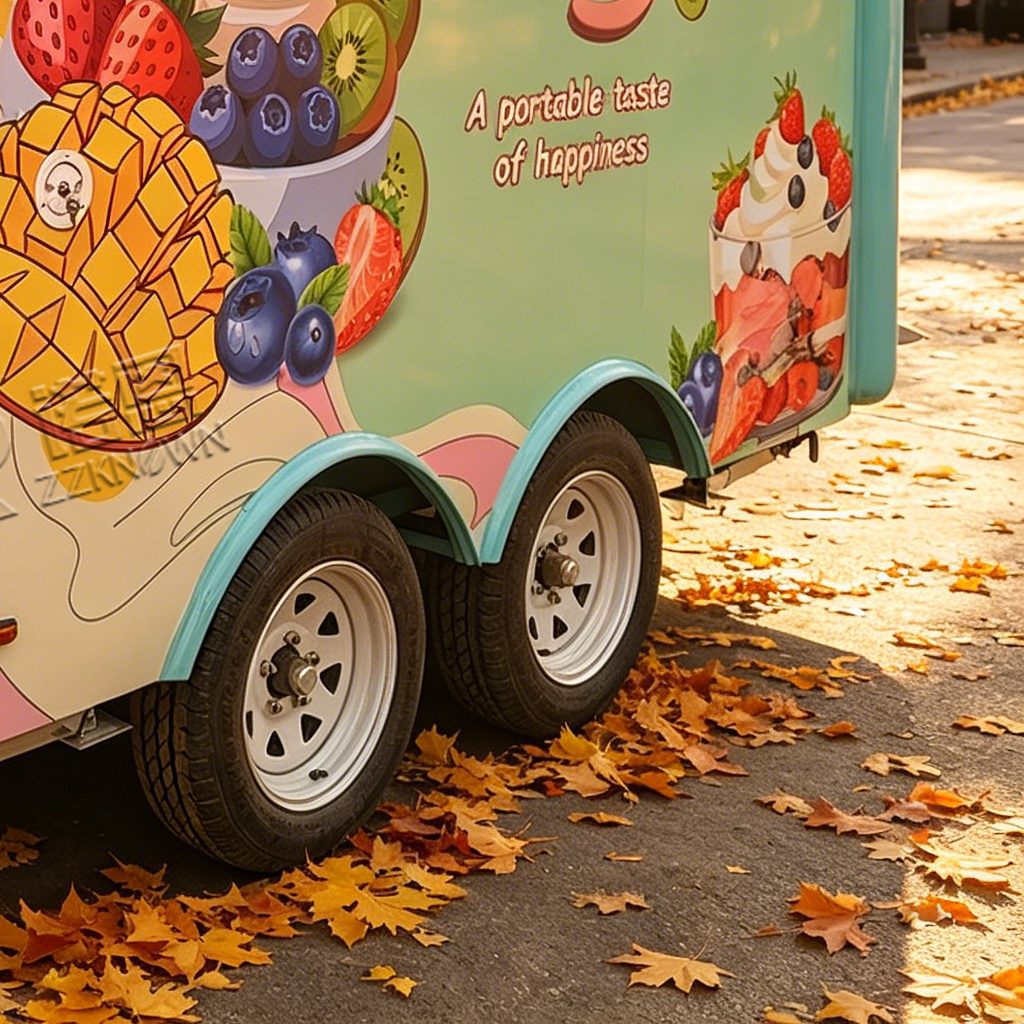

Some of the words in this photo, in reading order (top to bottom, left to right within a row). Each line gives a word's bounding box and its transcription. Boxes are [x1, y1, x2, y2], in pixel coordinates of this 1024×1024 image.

[464, 88, 487, 132] A
[495, 74, 606, 141] portable
[613, 73, 672, 112] taste
[493, 138, 528, 187] of
[533, 131, 649, 188] happiness
